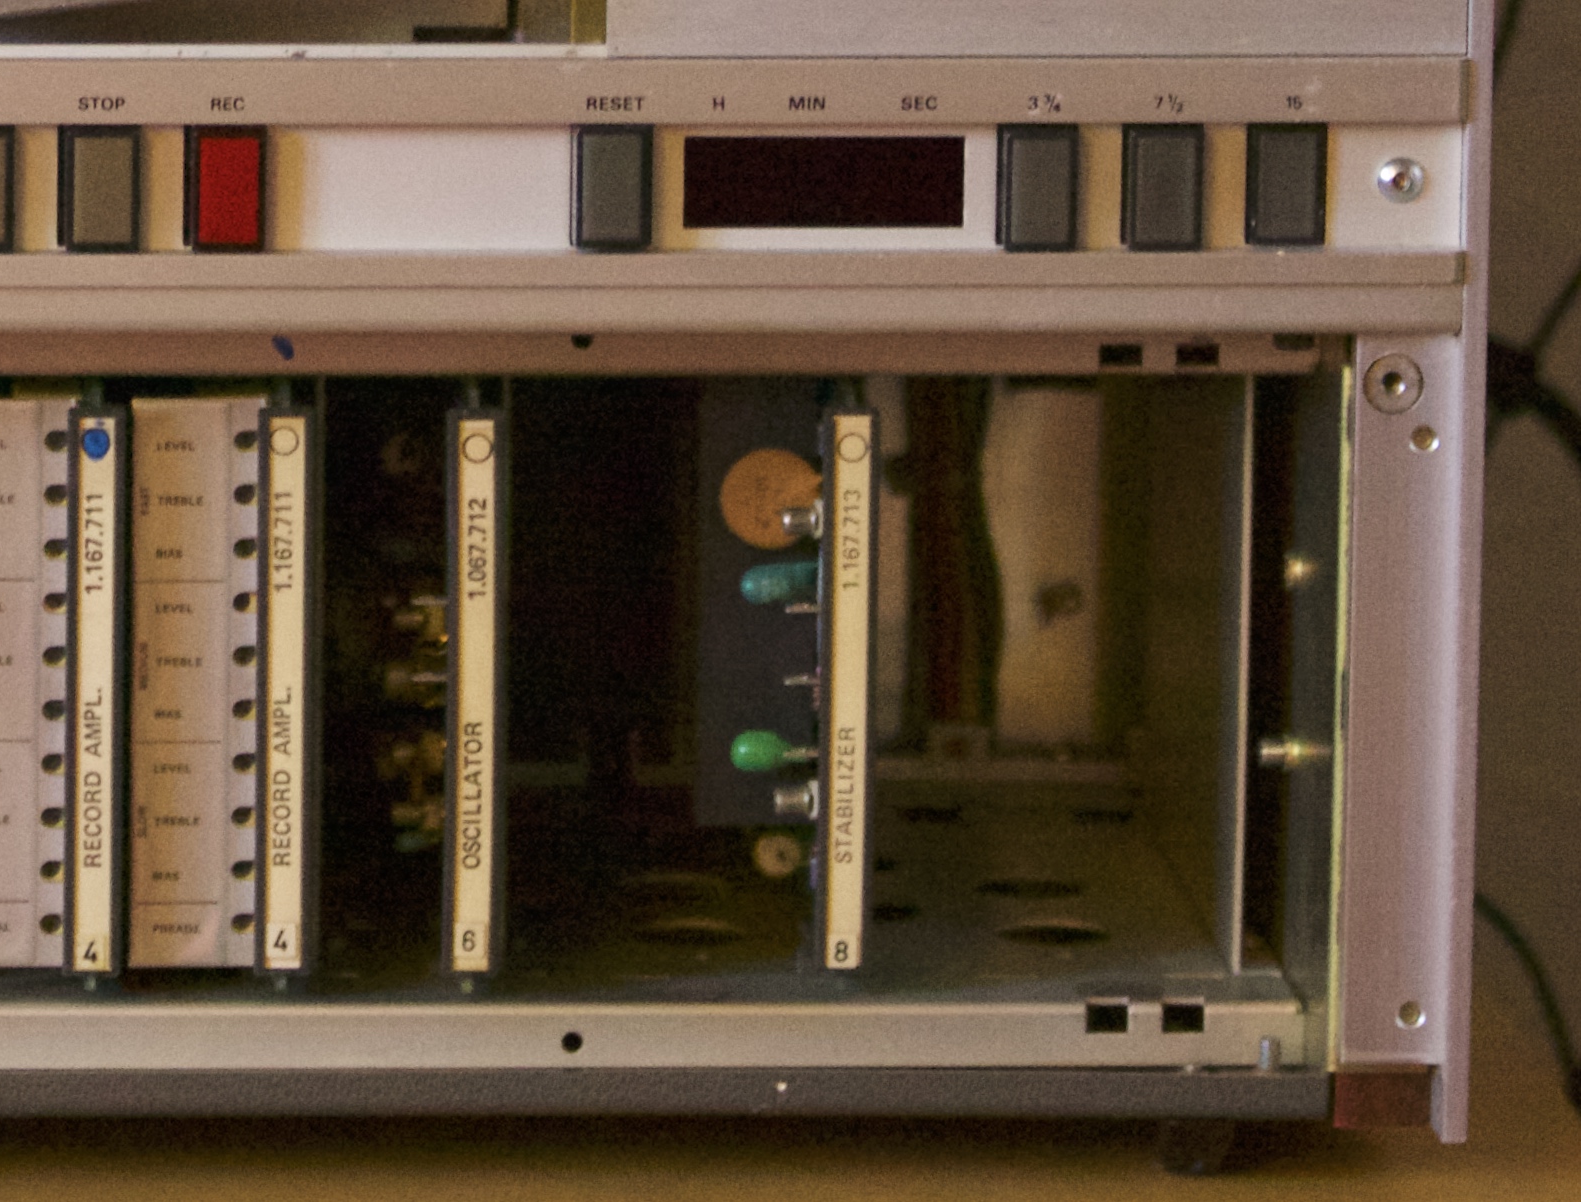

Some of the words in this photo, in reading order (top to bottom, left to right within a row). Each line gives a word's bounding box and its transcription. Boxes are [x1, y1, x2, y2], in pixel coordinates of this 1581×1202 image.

[78, 97, 126, 111] STOP
[210, 97, 246, 111] REC
[586, 96, 645, 111] RESET
[712, 97, 725, 111] H
[788, 97, 826, 111] MIN
[900, 97, 938, 111] SEC
[156, 441, 195, 451] LEVEL
[157, 495, 204, 506] TREBLE
[85, 493, 104, 595] 1.167.711
[274, 491, 293, 593] 1.167.711
[466, 496, 487, 600] 1.067.712
[842, 488, 862, 590] 1.167.713
[155, 603, 193, 614] LEVEL
[84, 687, 102, 757] AMPL.
[273, 687, 292, 756] AMPL.
[153, 763, 191, 774] LEVEL
[461, 721, 484, 870] OSCILLATOR
[834, 726, 856, 865] STABILIZER
[83, 771, 102, 868] RECORD
[273, 769, 291, 867] RECORD
[274, 928, 287, 951] 4
[461, 930, 476, 953] 6
[83, 940, 97, 963] 4
[833, 940, 849, 964] 8
